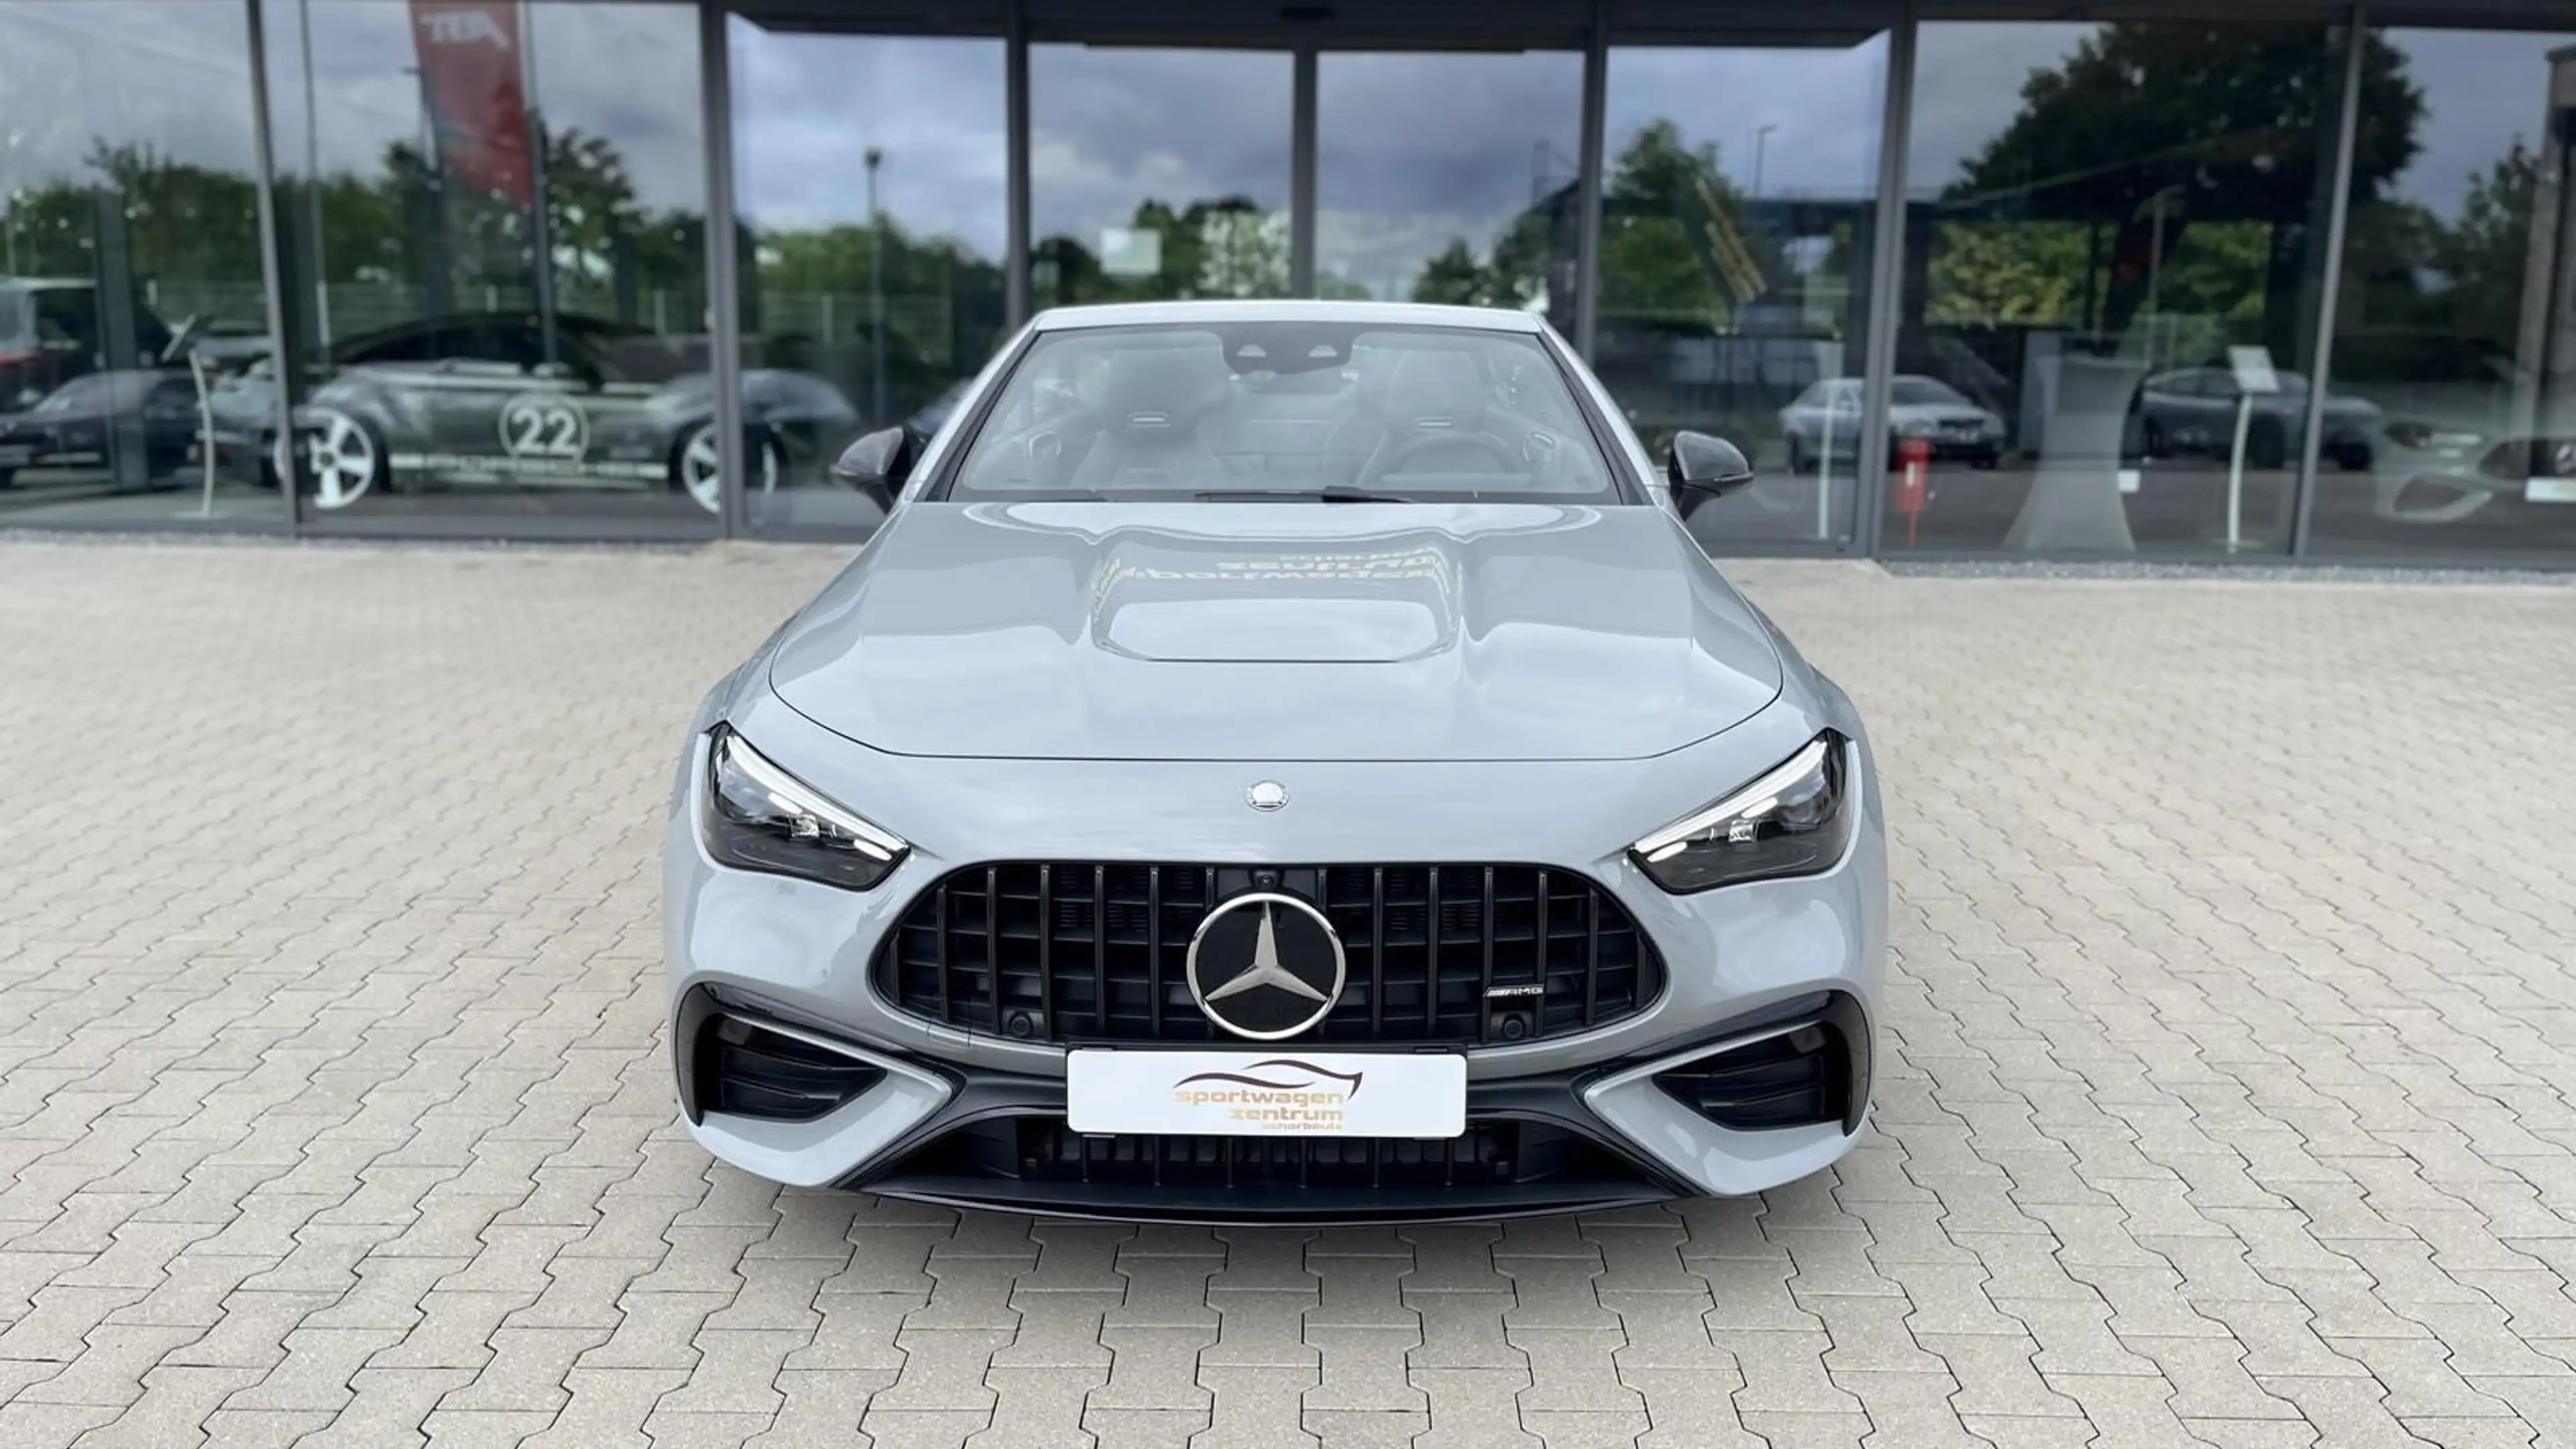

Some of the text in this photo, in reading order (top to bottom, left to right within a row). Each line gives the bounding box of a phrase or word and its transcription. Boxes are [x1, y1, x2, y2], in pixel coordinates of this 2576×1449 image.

[512, 409, 579, 453] 22
[1174, 1090, 1343, 1107] sportwagen
[1228, 1108, 1342, 1120] zentrum
